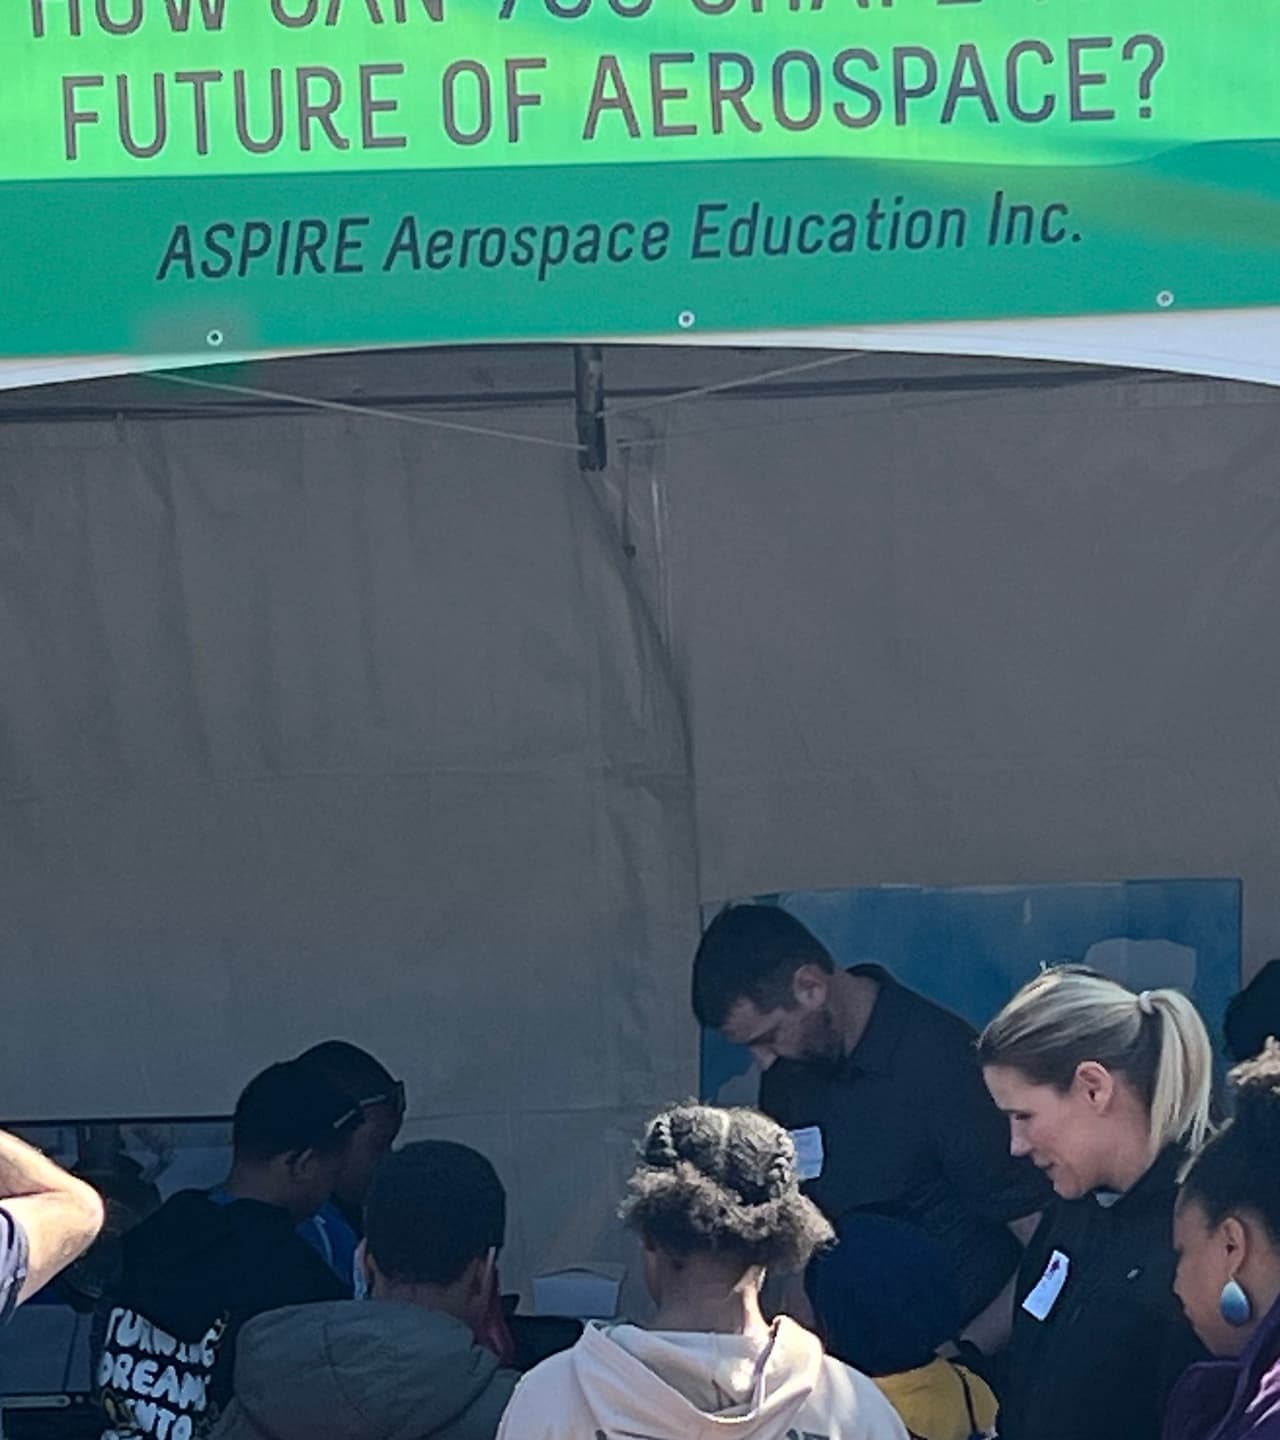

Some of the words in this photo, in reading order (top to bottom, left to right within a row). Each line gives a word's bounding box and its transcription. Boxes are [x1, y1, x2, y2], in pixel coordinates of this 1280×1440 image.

[61, 63, 408, 161] FUTURE
[440, 57, 548, 145] OF
[581, 34, 1167, 140] AEROSPACE?
[155, 216, 370, 281] ASPIRE
[381, 212, 671, 282] Aerospace
[690, 195, 967, 260] Education
[987, 190, 1083, 247] Inc.
